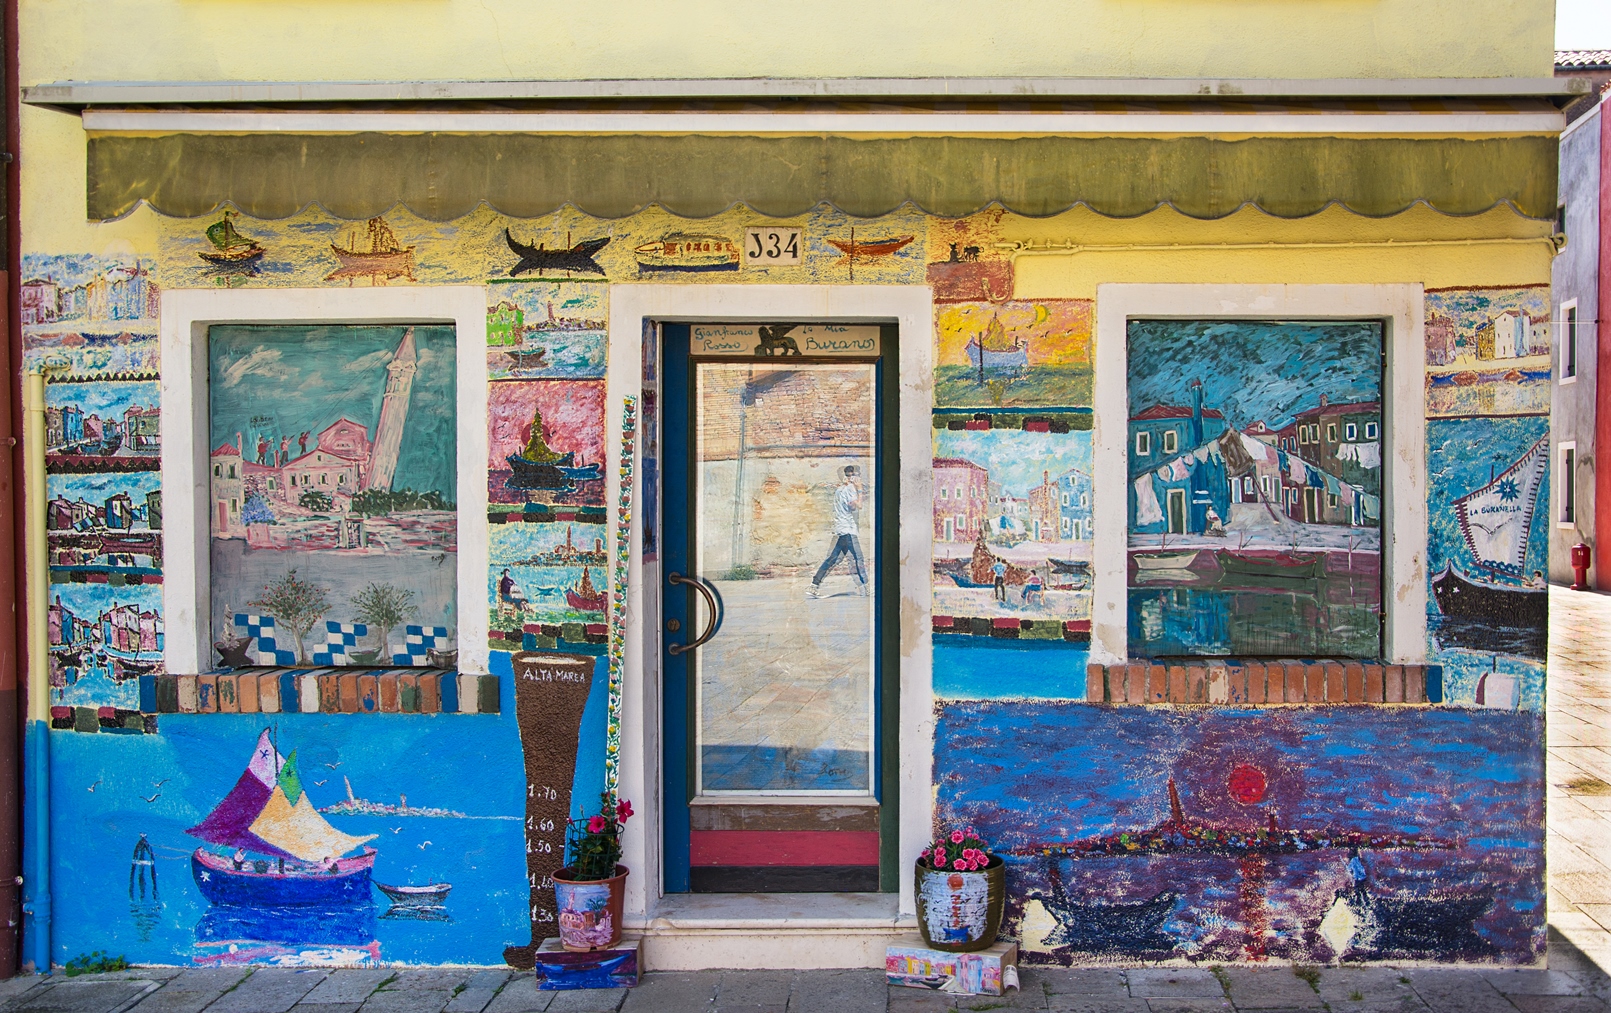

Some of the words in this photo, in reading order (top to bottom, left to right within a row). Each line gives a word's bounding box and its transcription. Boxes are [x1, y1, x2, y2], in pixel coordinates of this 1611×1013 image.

[703, 339, 742, 352] Rosso
[805, 336, 876, 352] Burano
[555, 669, 586, 683] MAREA
[527, 783, 557, 800] 1.70
[526, 815, 555, 831] 1.60
[525, 838, 552, 853] 1.50
